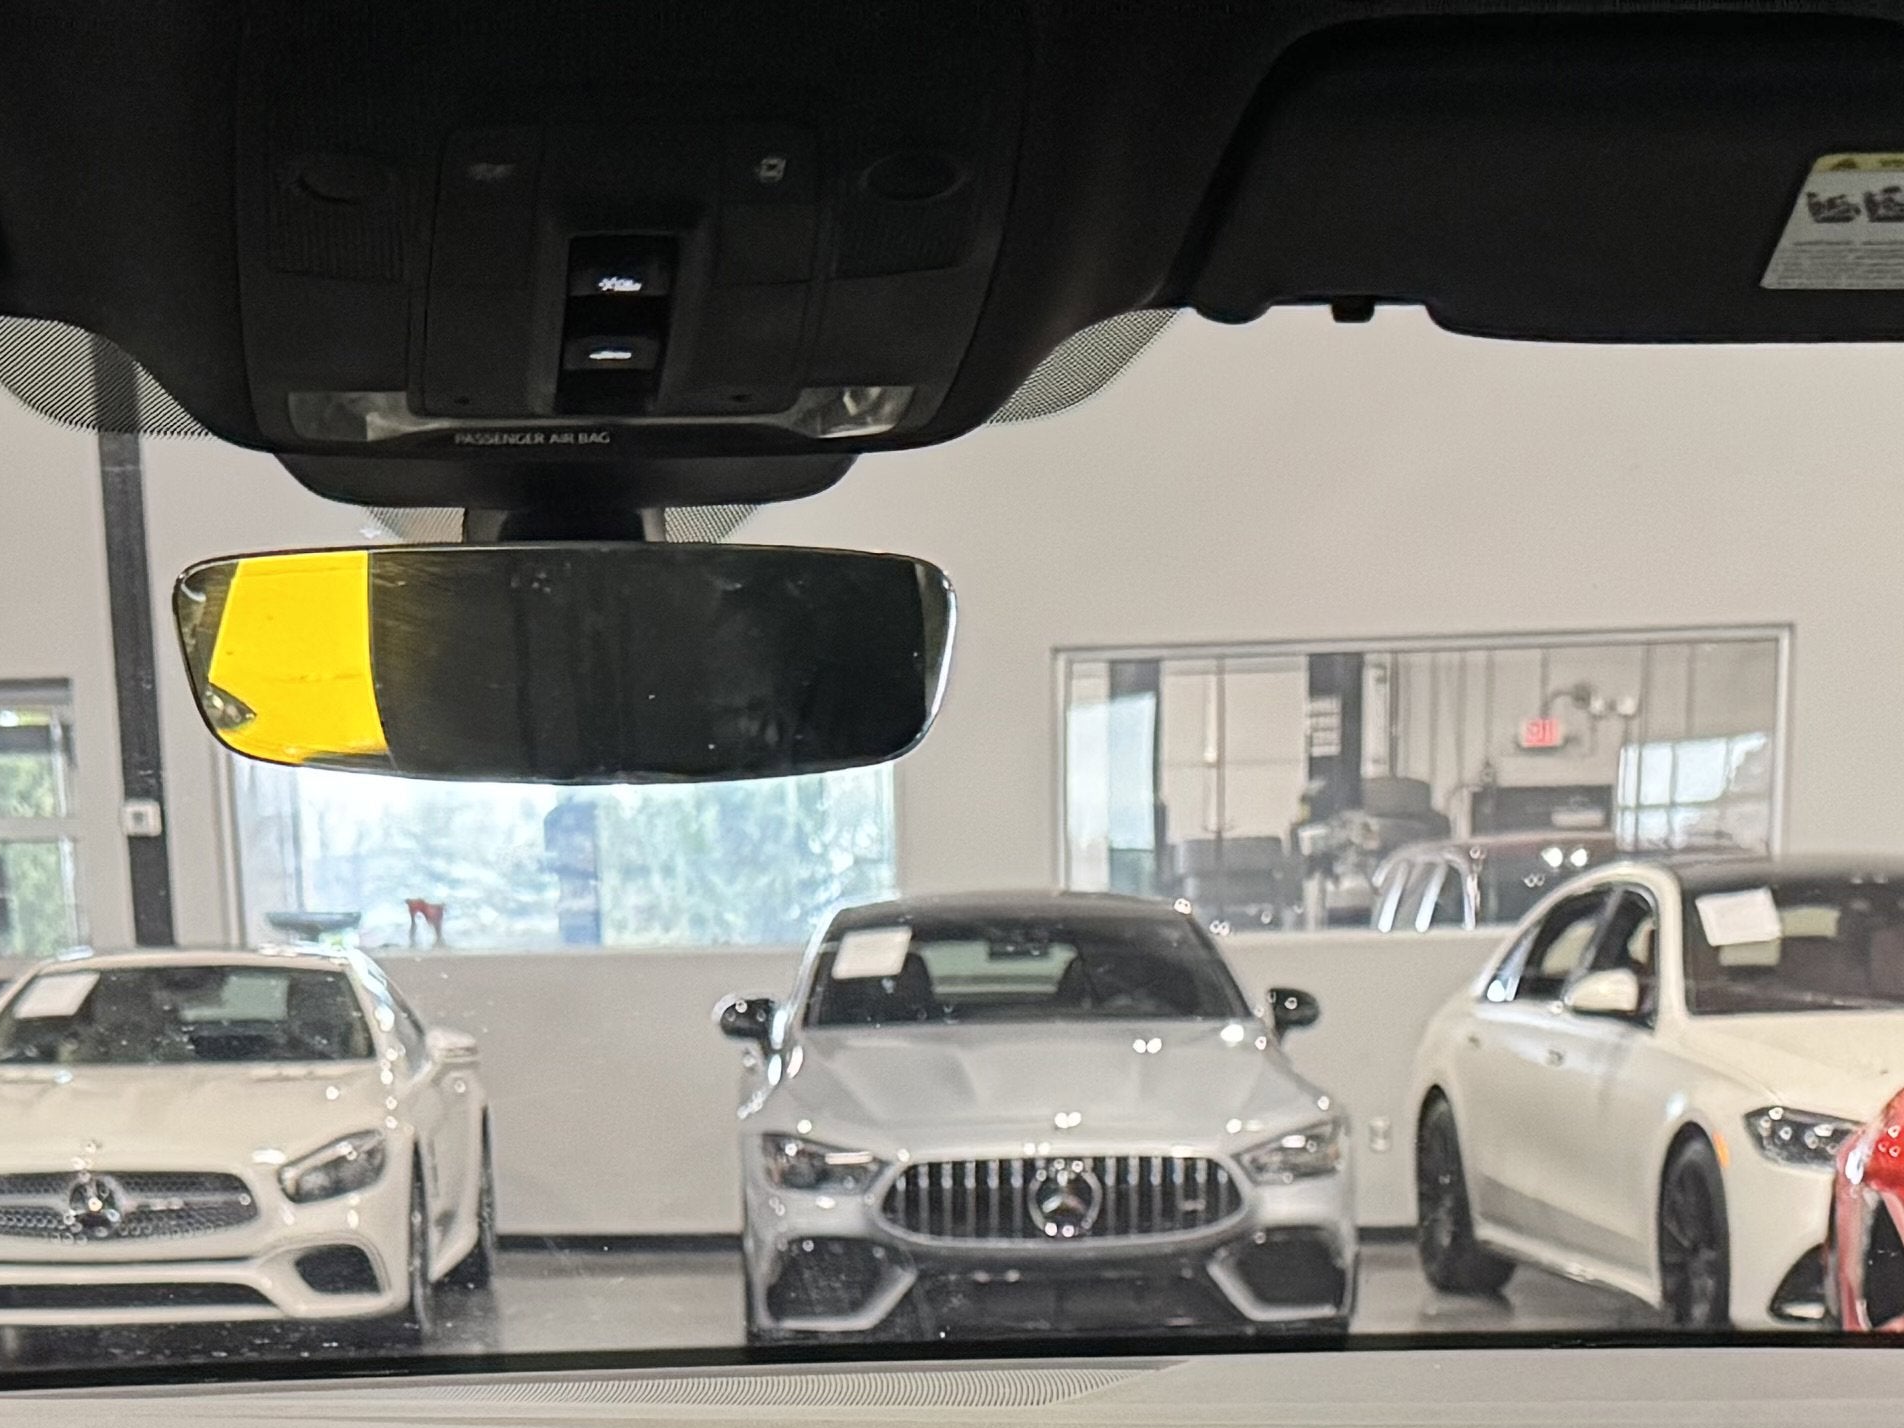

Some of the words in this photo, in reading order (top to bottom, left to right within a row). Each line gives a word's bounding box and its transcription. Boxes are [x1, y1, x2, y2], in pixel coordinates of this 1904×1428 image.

[454, 433, 545, 445] PASSENGER
[549, 433, 575, 444] AIR
[578, 432, 611, 444] BAG
